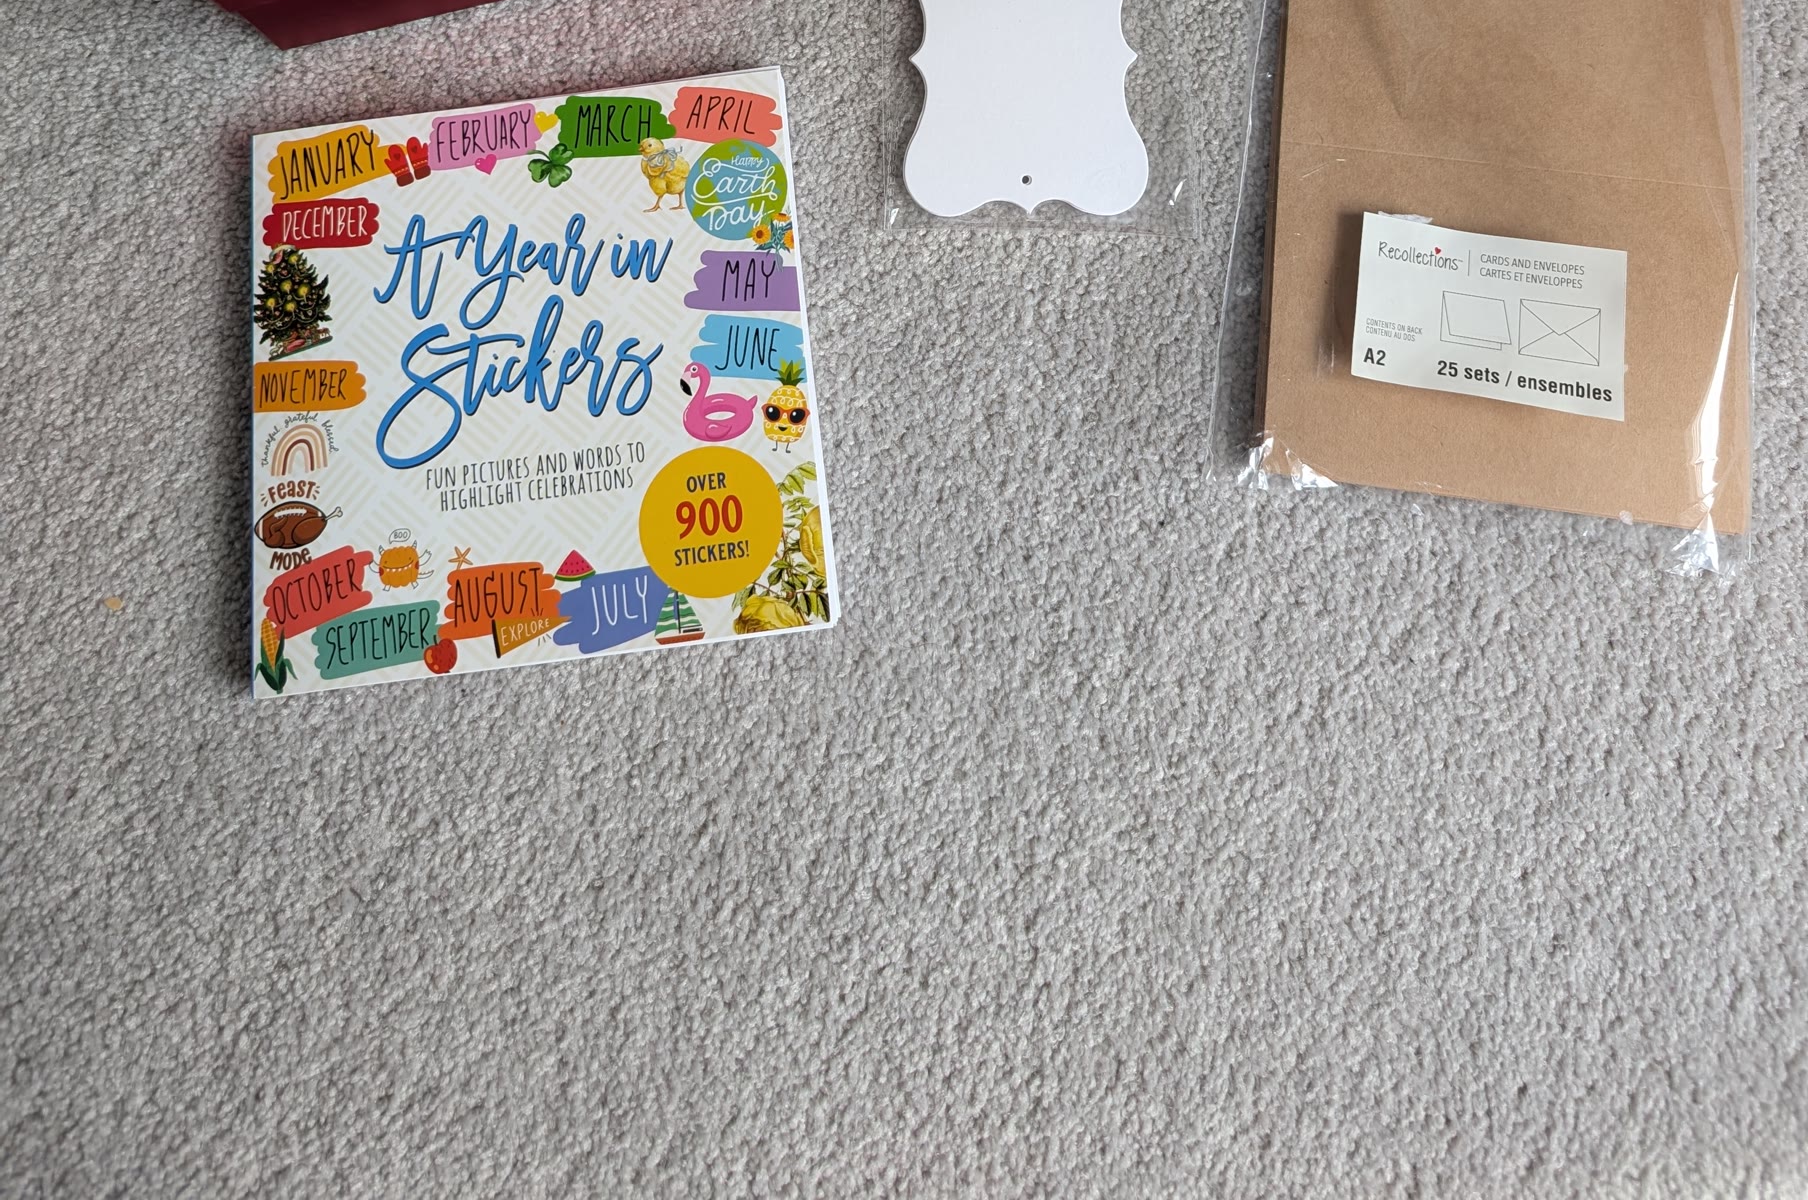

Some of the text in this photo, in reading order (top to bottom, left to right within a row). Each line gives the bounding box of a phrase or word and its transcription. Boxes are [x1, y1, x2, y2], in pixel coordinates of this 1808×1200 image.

[574, 103, 652, 148] MARCH
[686, 94, 756, 135] APRIL
[436, 109, 531, 163] FEBRUARY
[280, 129, 376, 200] JANUARY
[692, 160, 778, 202] Earth
[282, 205, 368, 243] DECEMBER
[702, 200, 776, 231] Day
[373, 212, 673, 330] A Year in
[1378, 241, 1460, 271] Recollections
[1480, 253, 1585, 276] CARDS AND ENVELOPES
[722, 258, 777, 302] MAY
[1480, 267, 1583, 290] CARTES ET ENVELOPPES
[715, 324, 780, 370] JUNE
[1365, 326, 1416, 342] CONTENU AU DOS
[1366, 318, 1423, 336] CONTENTS ON BACK
[1363, 347, 1387, 367] A2
[259, 367, 348, 409] NOVEMBER
[375, 294, 664, 469] Stickers
[1437, 360, 1613, 403] 25 sets / ensembles
[426, 441, 646, 491] FUN PICTURES AND WORDS TO
[686, 471, 727, 494] OVER
[440, 466, 634, 513] HIGHLIGHT CELEBRATIONS
[393, 531, 408, 541] BOO
[675, 494, 743, 540] 900
[674, 539, 750, 567] STICKERS!
[272, 558, 362, 625] OCTOBER
[454, 567, 542, 628] AUGUST
[591, 573, 649, 636] JULY
[325, 607, 431, 670] SEPTEMBER
[501, 617, 550, 647] EXPLORE
